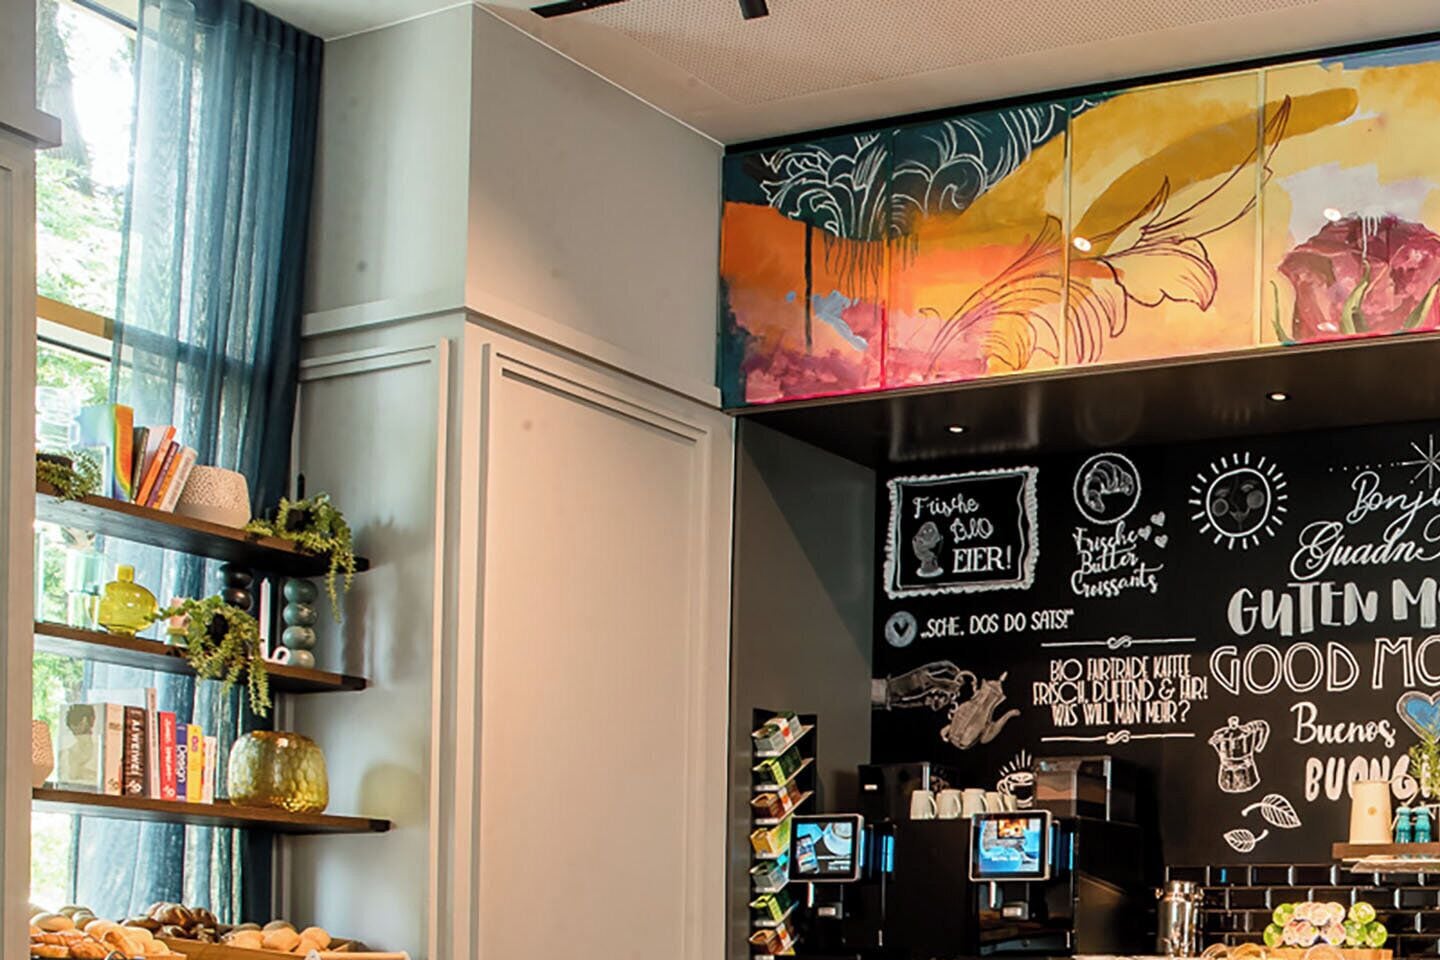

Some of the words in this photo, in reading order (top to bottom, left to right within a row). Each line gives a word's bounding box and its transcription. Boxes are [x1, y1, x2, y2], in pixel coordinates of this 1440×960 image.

[912, 493, 980, 519] Frische
[1072, 520, 1139, 553] Frische
[1290, 521, 1420, 580] Guadn
[952, 545, 1012, 574] EIER!
[1079, 544, 1139, 575] Butter
[1071, 562, 1164, 598] Croissants
[969, 613, 999, 634] DOS
[1004, 612, 1026, 632] DO
[1227, 581, 1379, 637] GUTEN
[1050, 658, 1083, 682] BIO
[1087, 655, 1150, 681] FAIRTRADE
[1153, 654, 1192, 679] KAFFEE
[1210, 641, 1360, 695] GOOD
[1092, 678, 1154, 703] DUFTEND
[1158, 678, 1176, 700] &
[1180, 676, 1209, 700] FAIR!
[1052, 703, 1079, 727] WAS
[1083, 702, 1110, 726] WILL
[1114, 701, 1141, 725] MAN
[1290, 701, 1397, 748] Buenos
